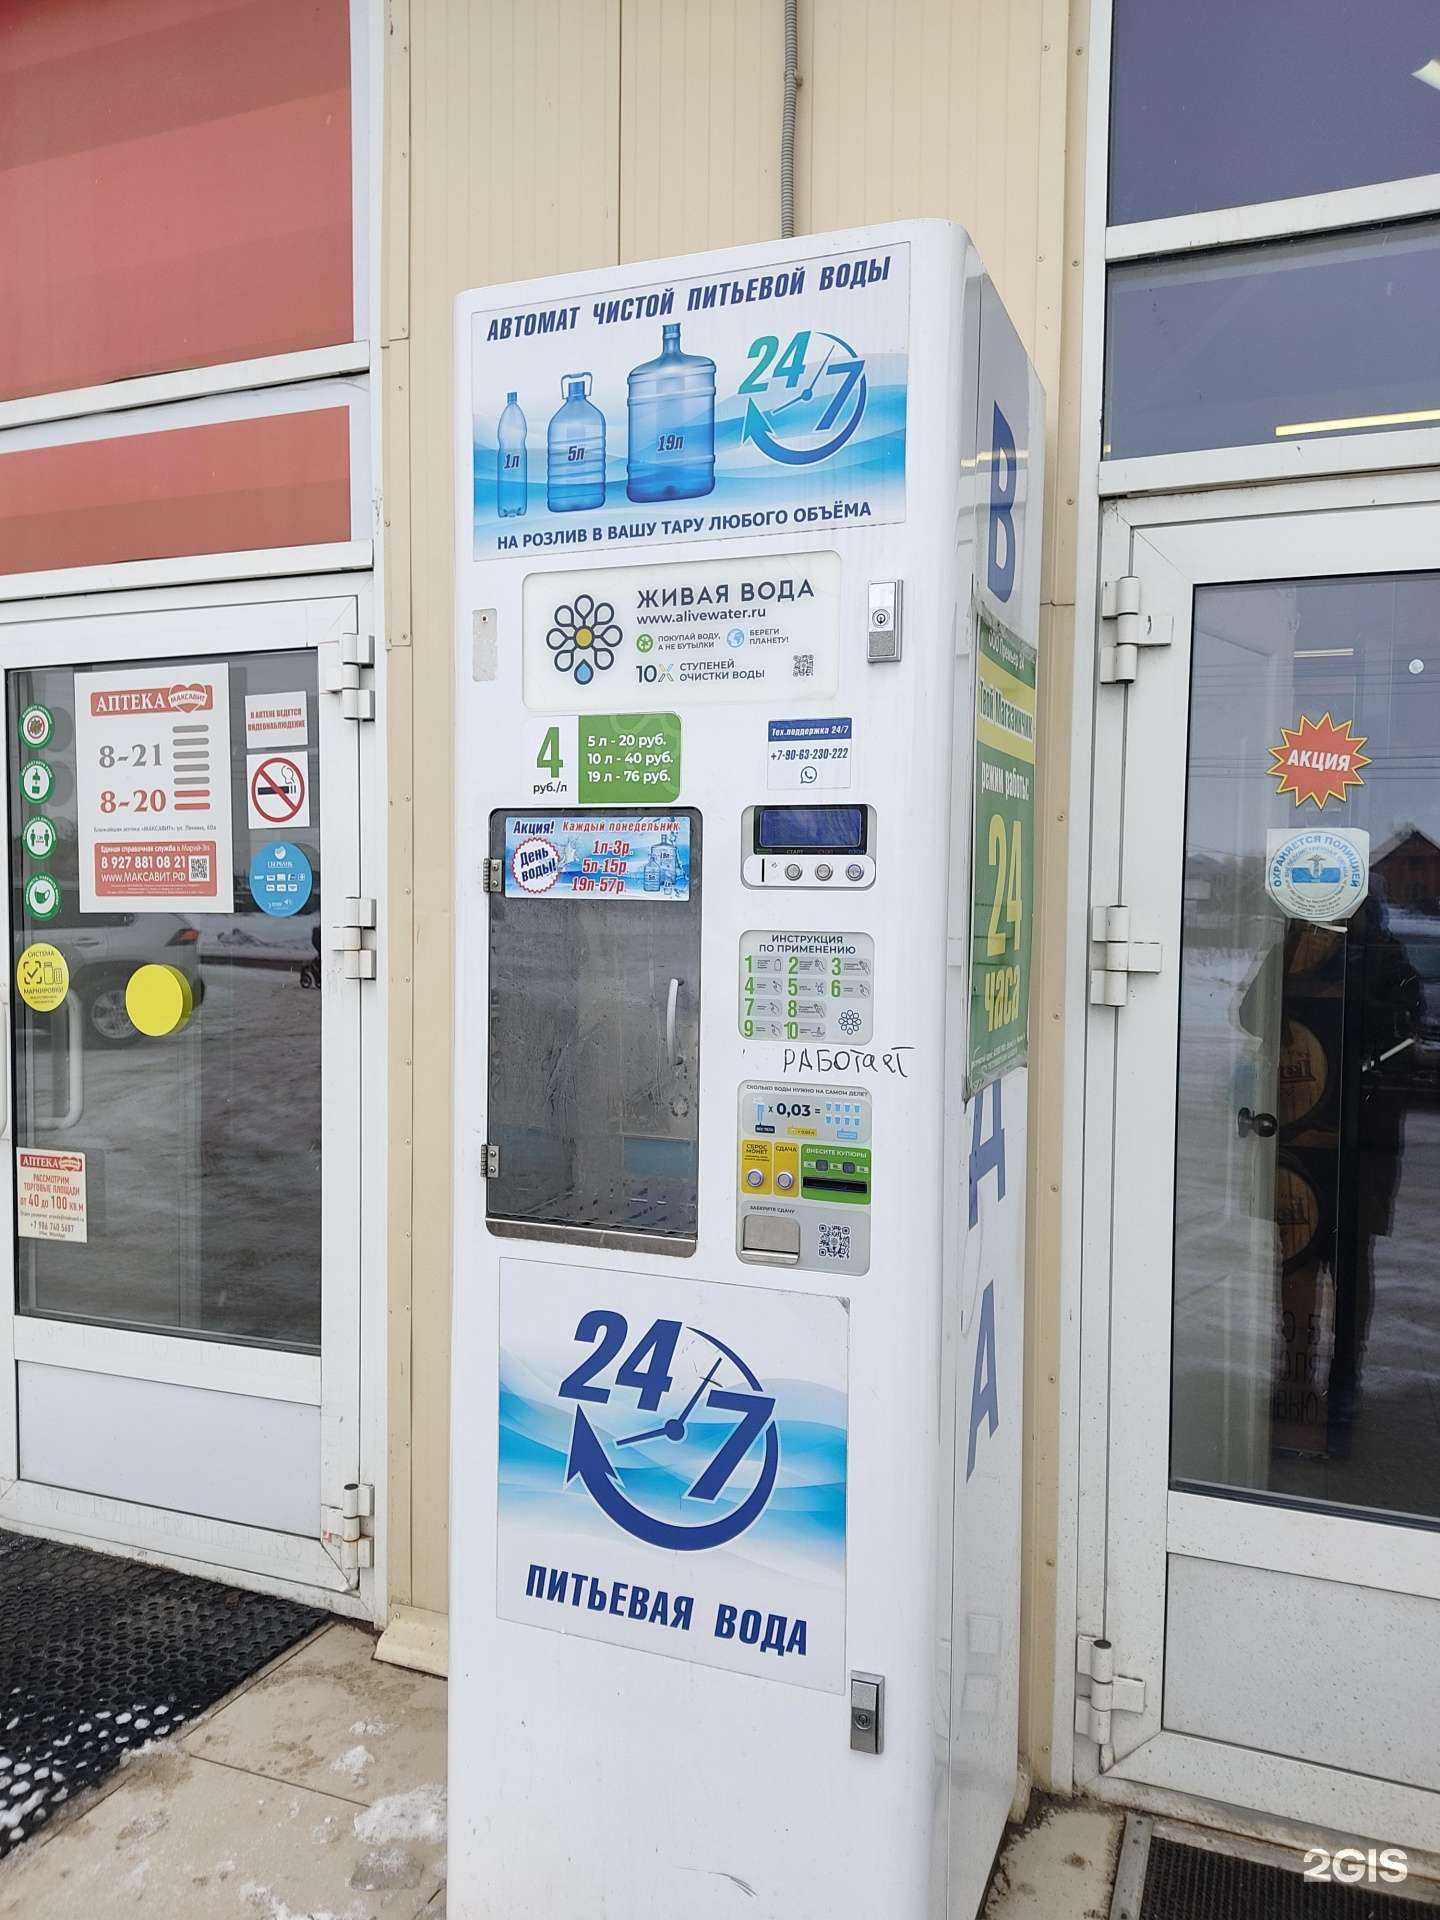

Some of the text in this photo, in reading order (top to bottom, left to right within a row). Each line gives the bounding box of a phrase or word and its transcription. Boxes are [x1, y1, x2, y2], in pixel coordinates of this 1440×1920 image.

[486, 256, 891, 342] АВТОМАТ ЧИСТОЙ ПИТЬЕВОЙ ВОДЫ
[737, 330, 866, 431] 24 7
[657, 433, 684, 453] 19л
[503, 453, 520, 470] 1л
[567, 445, 585, 462] 5л
[497, 501, 872, 551] НА РОЗЛИВ В ВАШУ ТАРУ ЛЮБОГО ОБЪЁМА
[637, 579, 815, 609] ЖИВАЯ ВОДА
[636, 607, 766, 625] www.alivewater.ru
[658, 632, 721, 642] ПОКУПАЙ ВОДУ,
[749, 628, 780, 636] БЕРЕГИ
[749, 637, 789, 645] ПЛАНЕТУ!
[677, 642, 715, 650] БУТЫЛКИ
[680, 659, 735, 671] СТУПЕНЕЙ
[679, 670, 765, 682] ОЧИСТКИ ВОДЫ
[96, 692, 166, 712] АПТЕКА
[277, 708, 301, 718] ВЕДЕТСЯ
[831, 725, 849, 735] 24/7
[588, 735, 595, 747] 5
[598, 737, 607, 746] л
[619, 735, 636, 747] 20
[638, 734, 666, 749] руб.
[99, 743, 162, 768] 8-21
[536, 727, 563, 778] 4
[588, 753, 601, 764] 10
[605, 755, 613, 764] л
[625, 753, 642, 764] 40
[645, 752, 674, 766] руб.
[771, 747, 849, 761] +7-90-63-230-222
[1287, 749, 1352, 772] АКЦИЯ
[588, 771, 601, 782] 19
[603, 773, 612, 782] л
[623, 770, 641, 782] 76
[643, 770, 671, 784] руб.
[981, 761, 1004, 793] режим
[533, 781, 567, 794] руб./л
[100, 788, 166, 813] 8-20
[513, 821, 681, 836] Акция! Каждый понедельник
[101, 856, 186, 869] 8 927 881 08 21
[520, 848, 549, 868] День
[1273, 835, 1321, 888] ОХРАНЯЕТСЯ
[1324, 835, 1361, 888] ПОЛИЦИЕЙ
[101, 872, 186, 883] www.МАКСАВИТ.РФ
[522, 861, 557, 882] воды!
[987, 814, 1022, 957] 24
[772, 934, 843, 945] ИНСТРУКЦИЯ
[759, 944, 856, 955] ПО ПРИМЕНЕНИЮ
[744, 955, 752, 973] 1
[788, 956, 799, 974] 2
[832, 957, 842, 976] 3
[744, 977, 755, 995] 4
[788, 978, 798, 996] 5
[831, 979, 841, 997] 6
[744, 998, 755, 1016] 7
[788, 1000, 797, 1018] 8
[744, 1019, 753, 1037] 9
[784, 1021, 799, 1040] 10
[776, 1103, 811, 1117] 0,03
[806, 1147, 867, 1159] ВНЕСИТЕ КУПЮРЫ
[22, 1156, 59, 1169] АПТЕКА
[33, 1174, 70, 1185] РАССМОТРИМ
[24, 1182, 80, 1196] ТОРГОВЫЕ ПЛОЩАДИ
[28, 1194, 39, 1208] 40
[51, 1196, 67, 1210] 100
[558, 1309, 776, 1501] 24 7
[525, 1564, 808, 1657] ПИТЬЕВАЯ ВОДА
